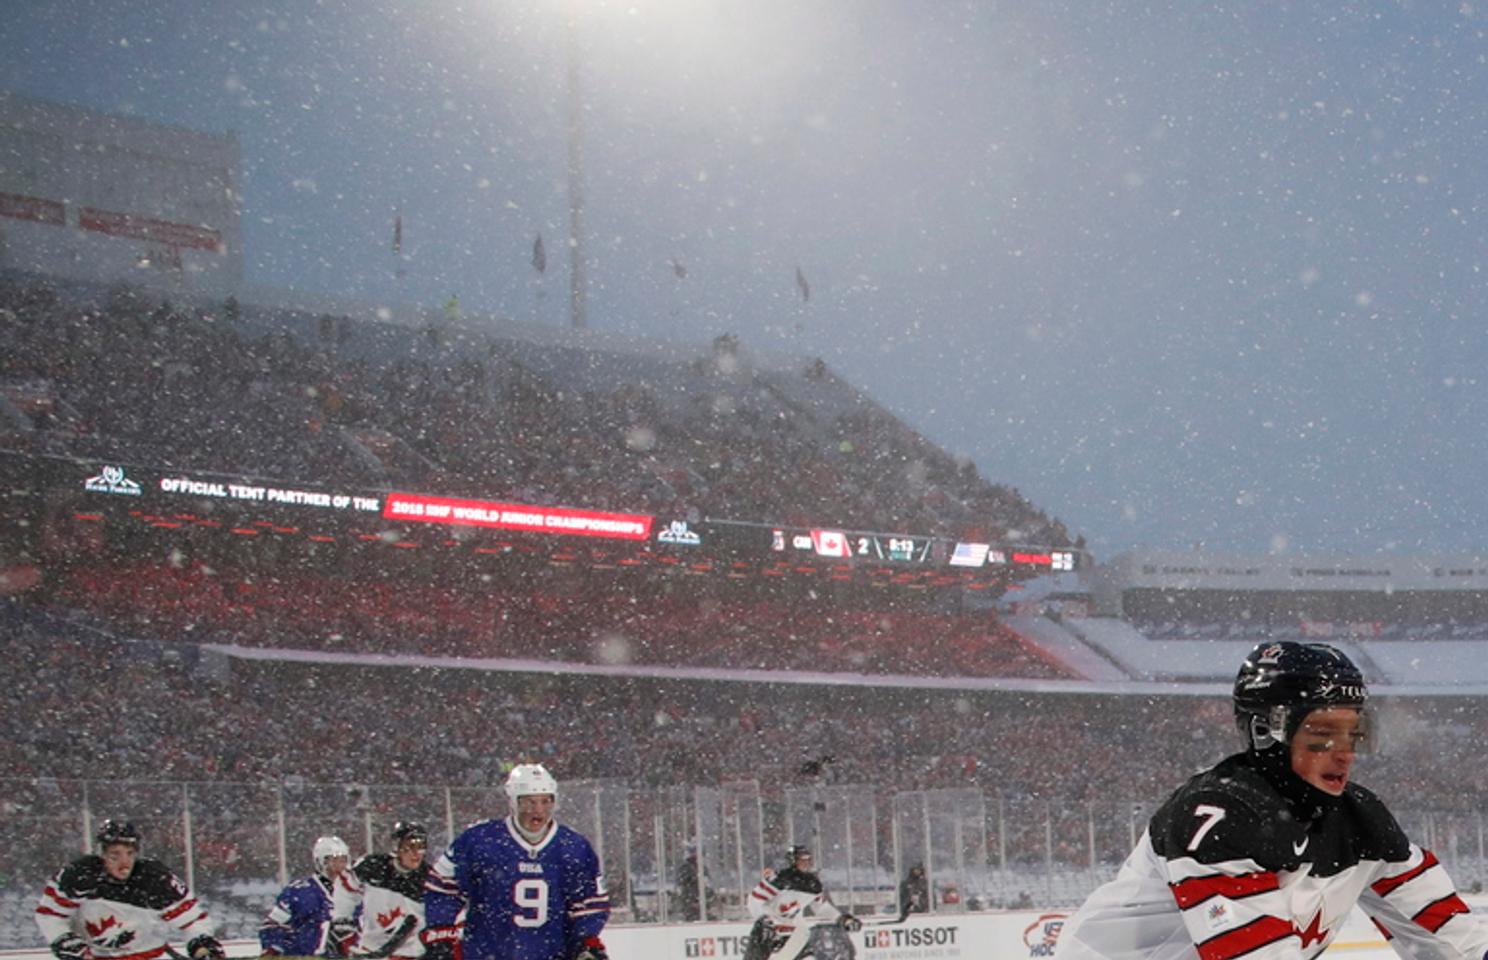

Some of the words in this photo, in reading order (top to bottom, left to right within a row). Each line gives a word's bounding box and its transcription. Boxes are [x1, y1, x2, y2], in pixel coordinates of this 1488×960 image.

[161, 477, 228, 498] OFFICIAL
[228, 484, 266, 501] TENT
[267, 488, 331, 507] PARTNER
[333, 495, 351, 508] OF
[352, 497, 379, 511] THE
[453, 506, 499, 523] WORLD
[545, 514, 645, 536] CHAMPIONSHIPS
[858, 538, 869, 554] 2
[1185, 803, 1226, 853] 7
[512, 878, 549, 929] 9
[717, 935, 750, 957] TIS
[891, 926, 958, 948] TISSOT
[1029, 943, 1055, 957] HOC
